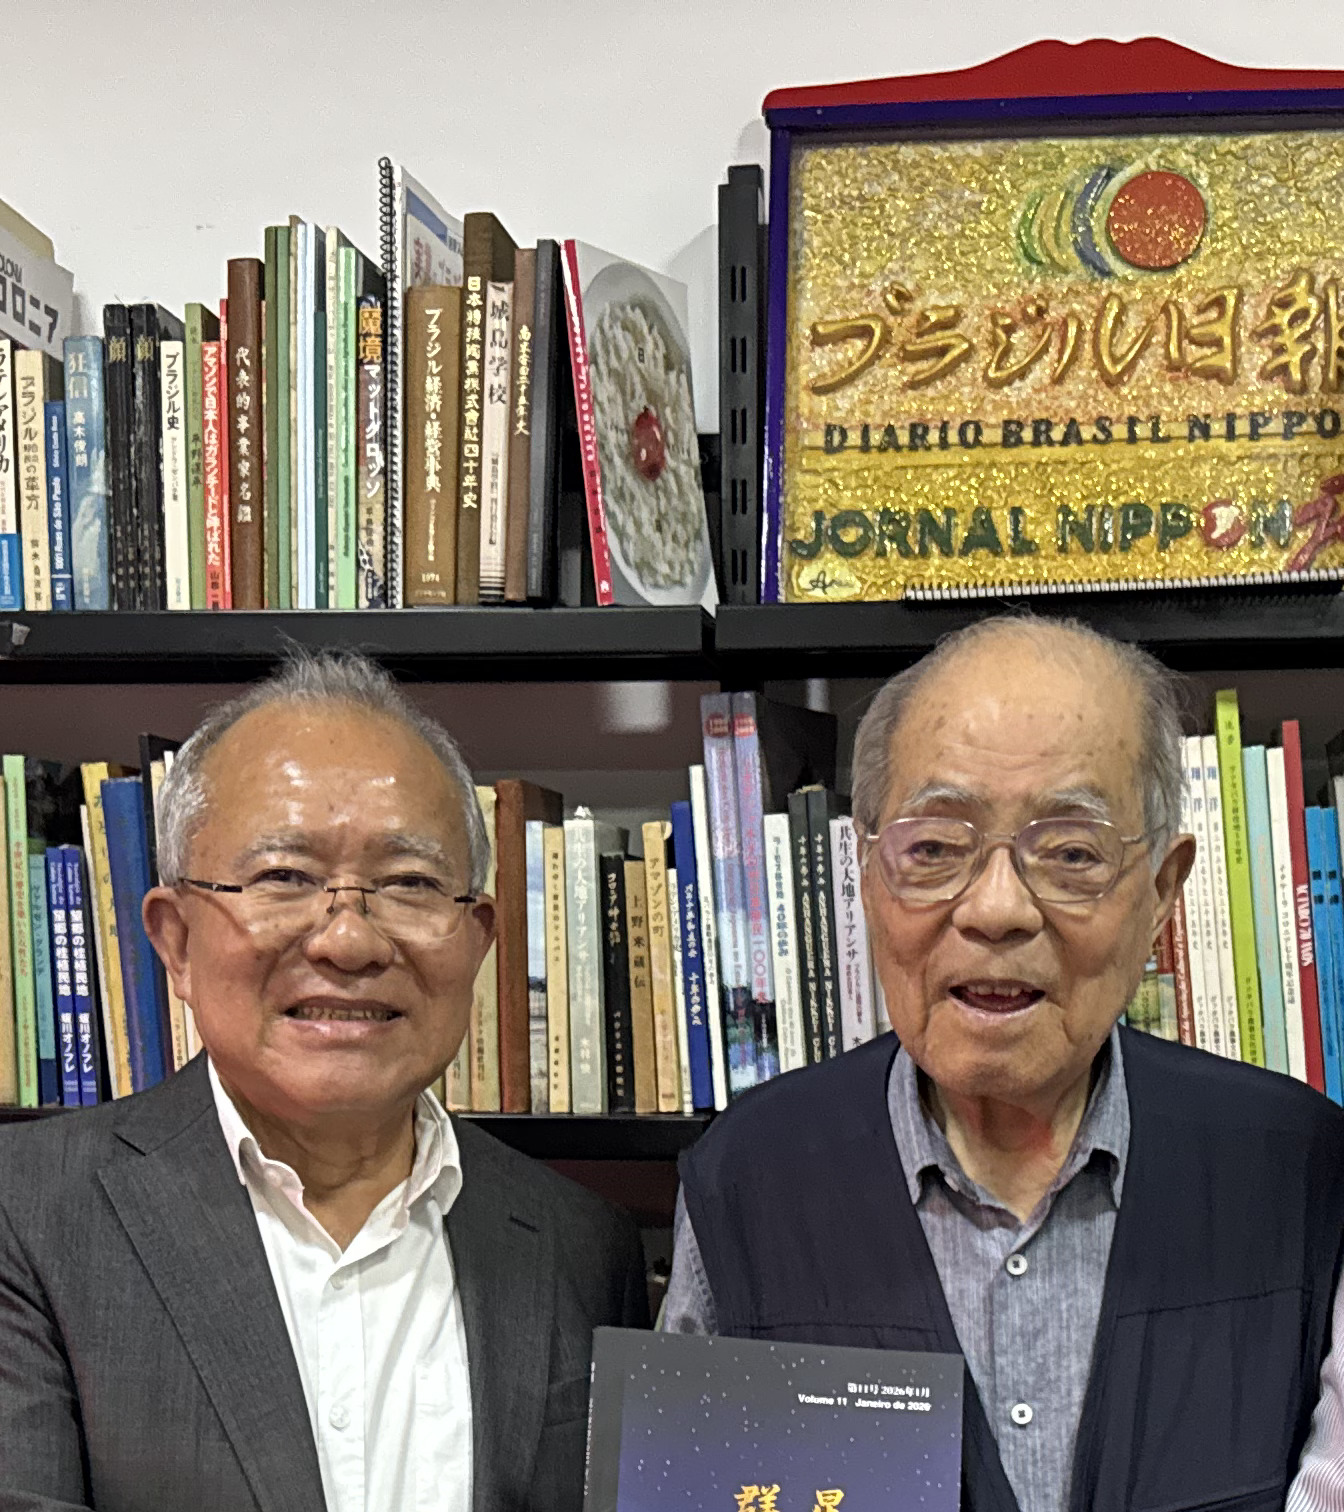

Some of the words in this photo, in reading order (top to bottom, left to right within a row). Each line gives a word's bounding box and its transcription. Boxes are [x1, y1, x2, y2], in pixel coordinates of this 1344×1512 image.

[165, 353, 181, 430] ブラジル史
[363, 364, 385, 499] マットグロッソ
[825, 421, 982, 454] DIARIO
[1001, 416, 1178, 449] BRASIL
[791, 507, 1039, 559] JORNAL
[650, 858, 665, 938] アマゾンの町
[798, 1394, 834, 1405] Volume
[837, 1397, 847, 1406] 11
[855, 1398, 891, 1409] Janeiro
[893, 1402, 905, 1410] de
